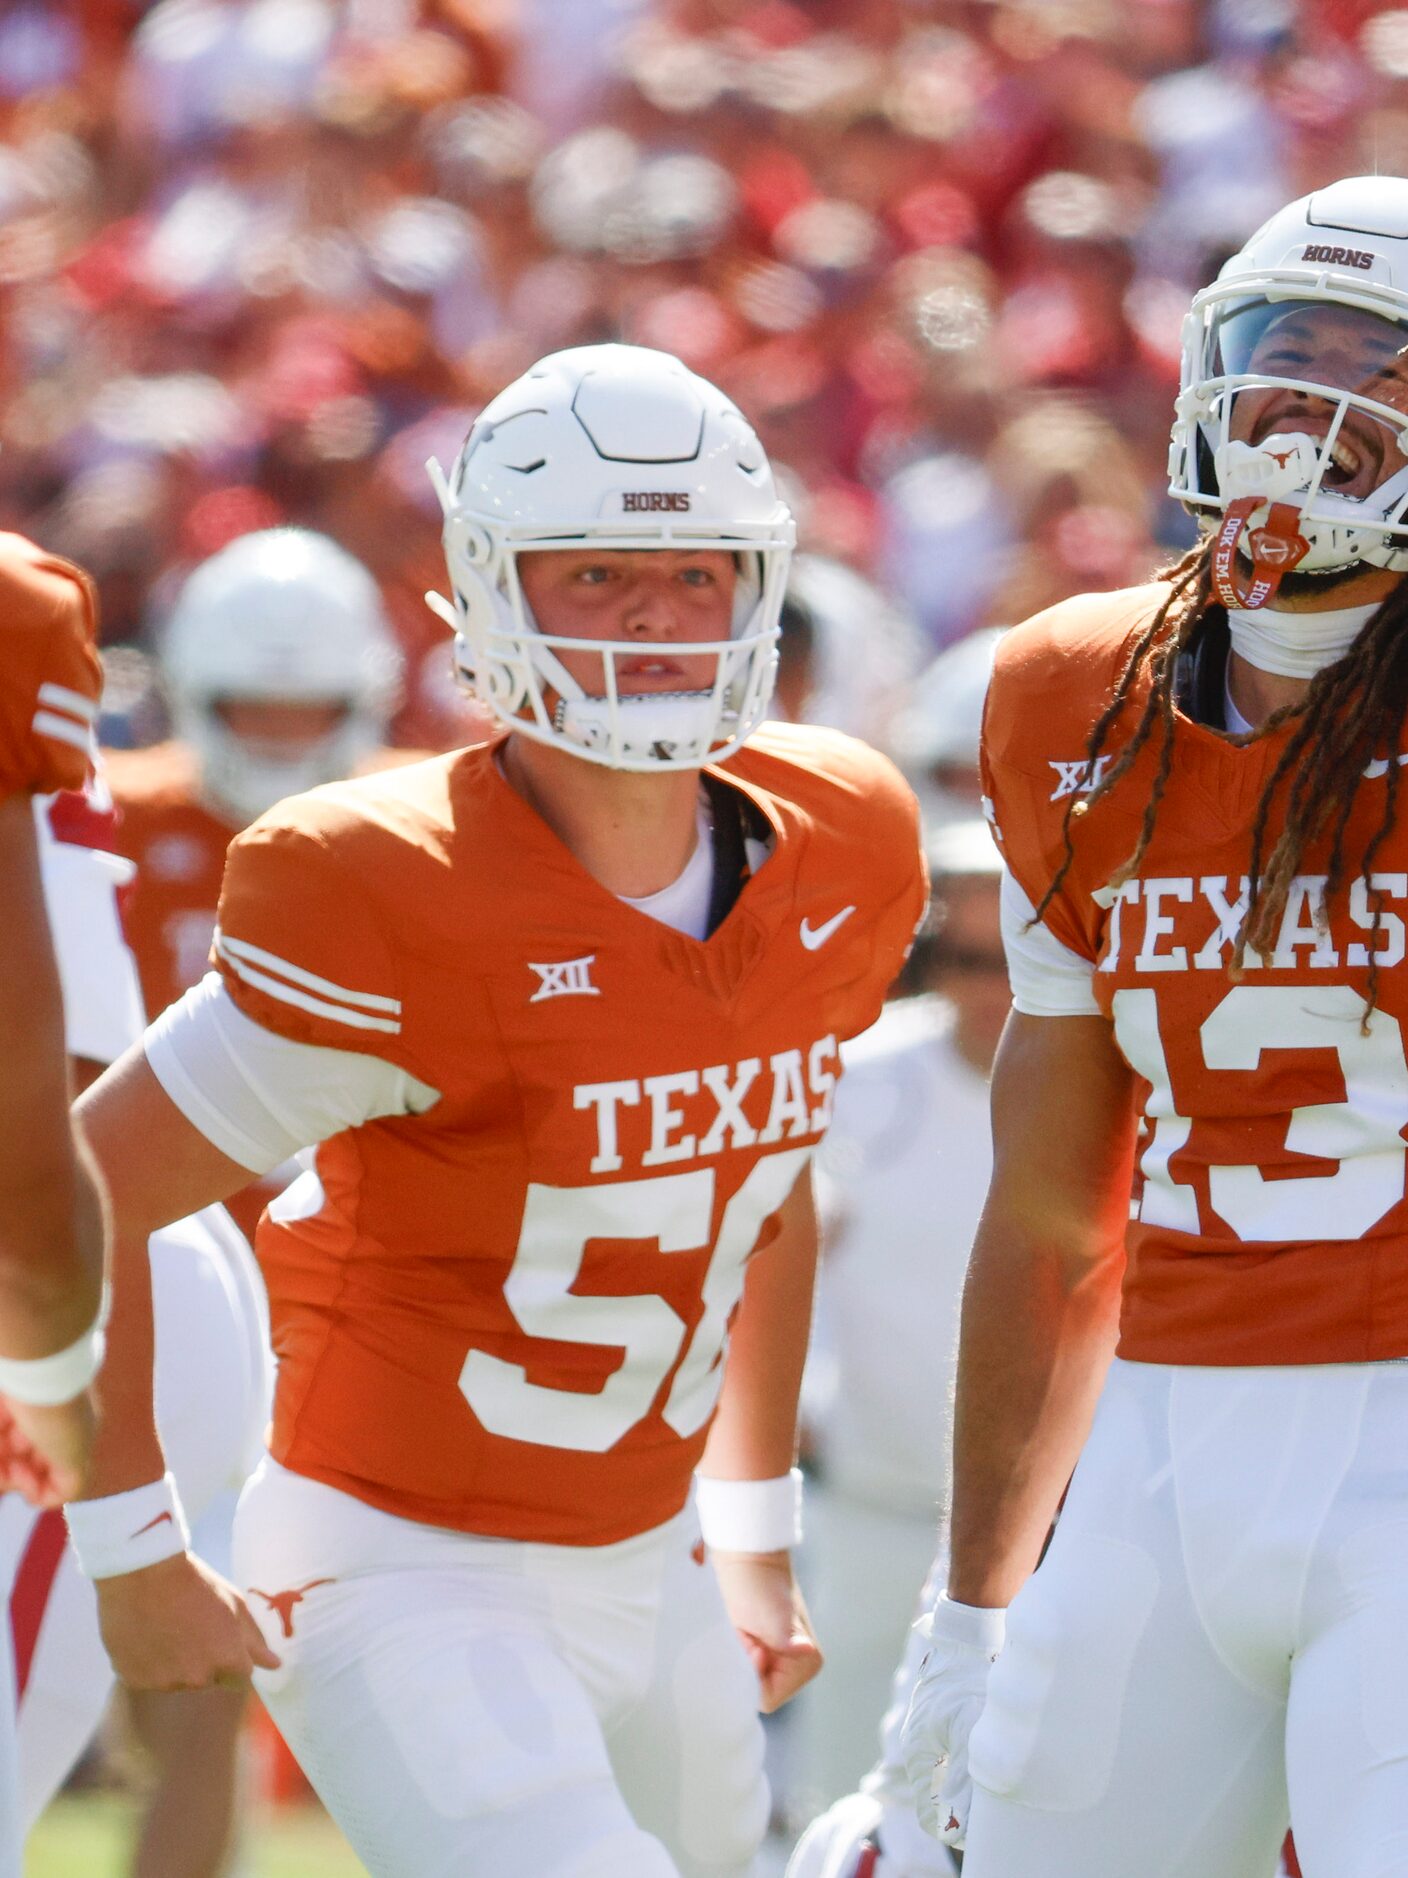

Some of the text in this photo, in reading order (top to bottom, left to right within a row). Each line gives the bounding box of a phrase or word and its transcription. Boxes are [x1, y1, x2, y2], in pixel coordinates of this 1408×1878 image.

[1301, 244, 1375, 270] HORNS
[622, 492, 690, 512] HORNS
[1091, 873, 1408, 973] TEXAS
[527, 954, 601, 1003] XII
[573, 1033, 839, 1174] TEXAS
